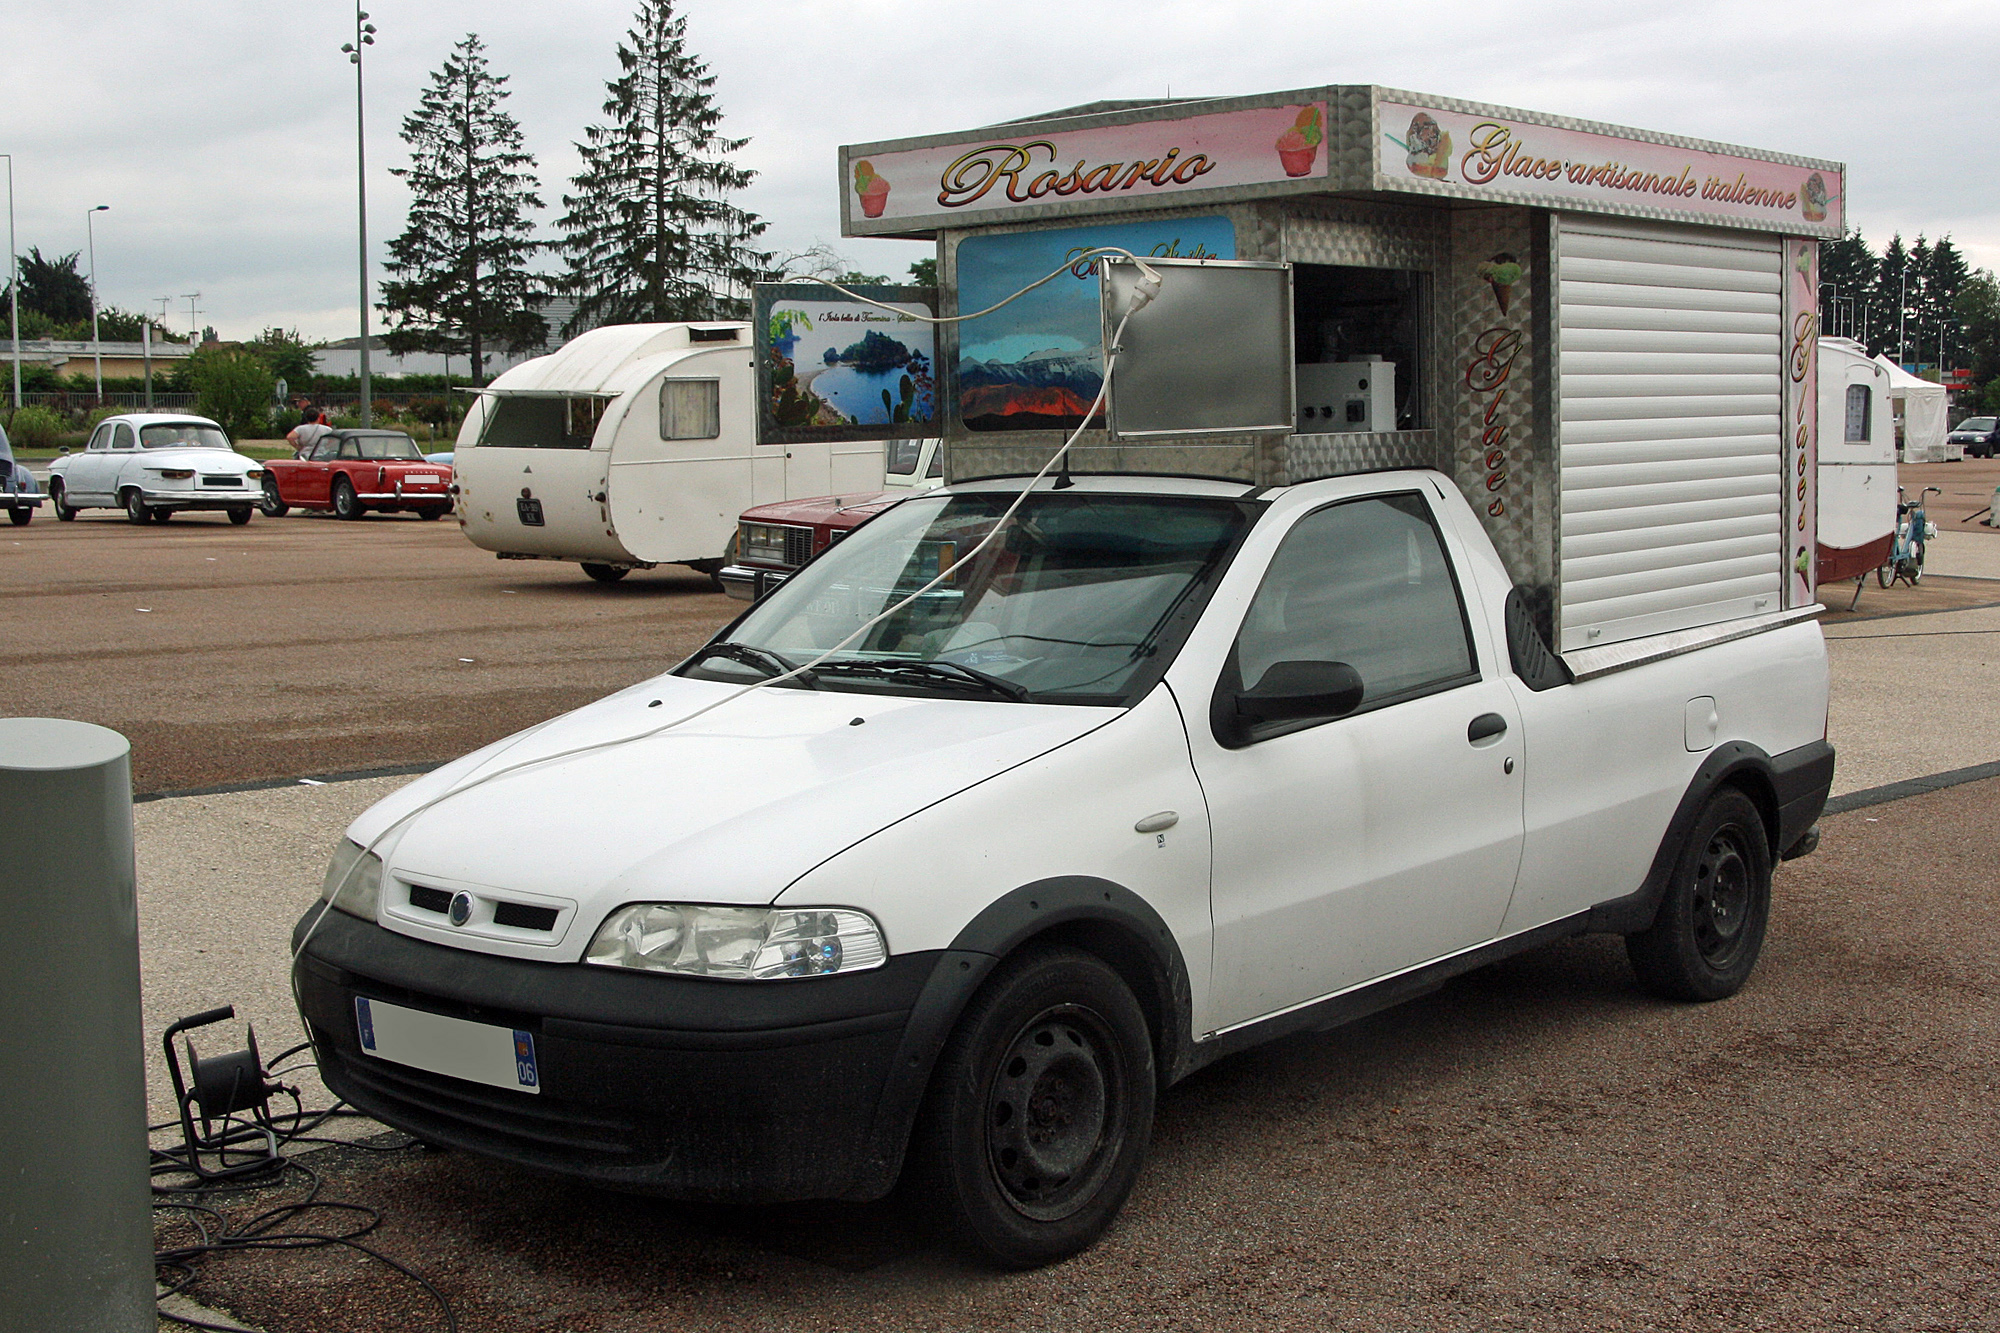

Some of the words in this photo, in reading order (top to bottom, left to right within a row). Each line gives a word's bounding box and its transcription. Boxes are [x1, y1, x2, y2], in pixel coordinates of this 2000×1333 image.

[936, 139, 1217, 208] Rosario
[1461, 121, 1562, 185] Glace
[1568, 160, 1698, 198] artisanale
[1701, 172, 1797, 210] italienne
[1465, 327, 1523, 517] Glaces
[1790, 310, 1816, 532] Glaces
[518, 1061, 535, 1083] 06
